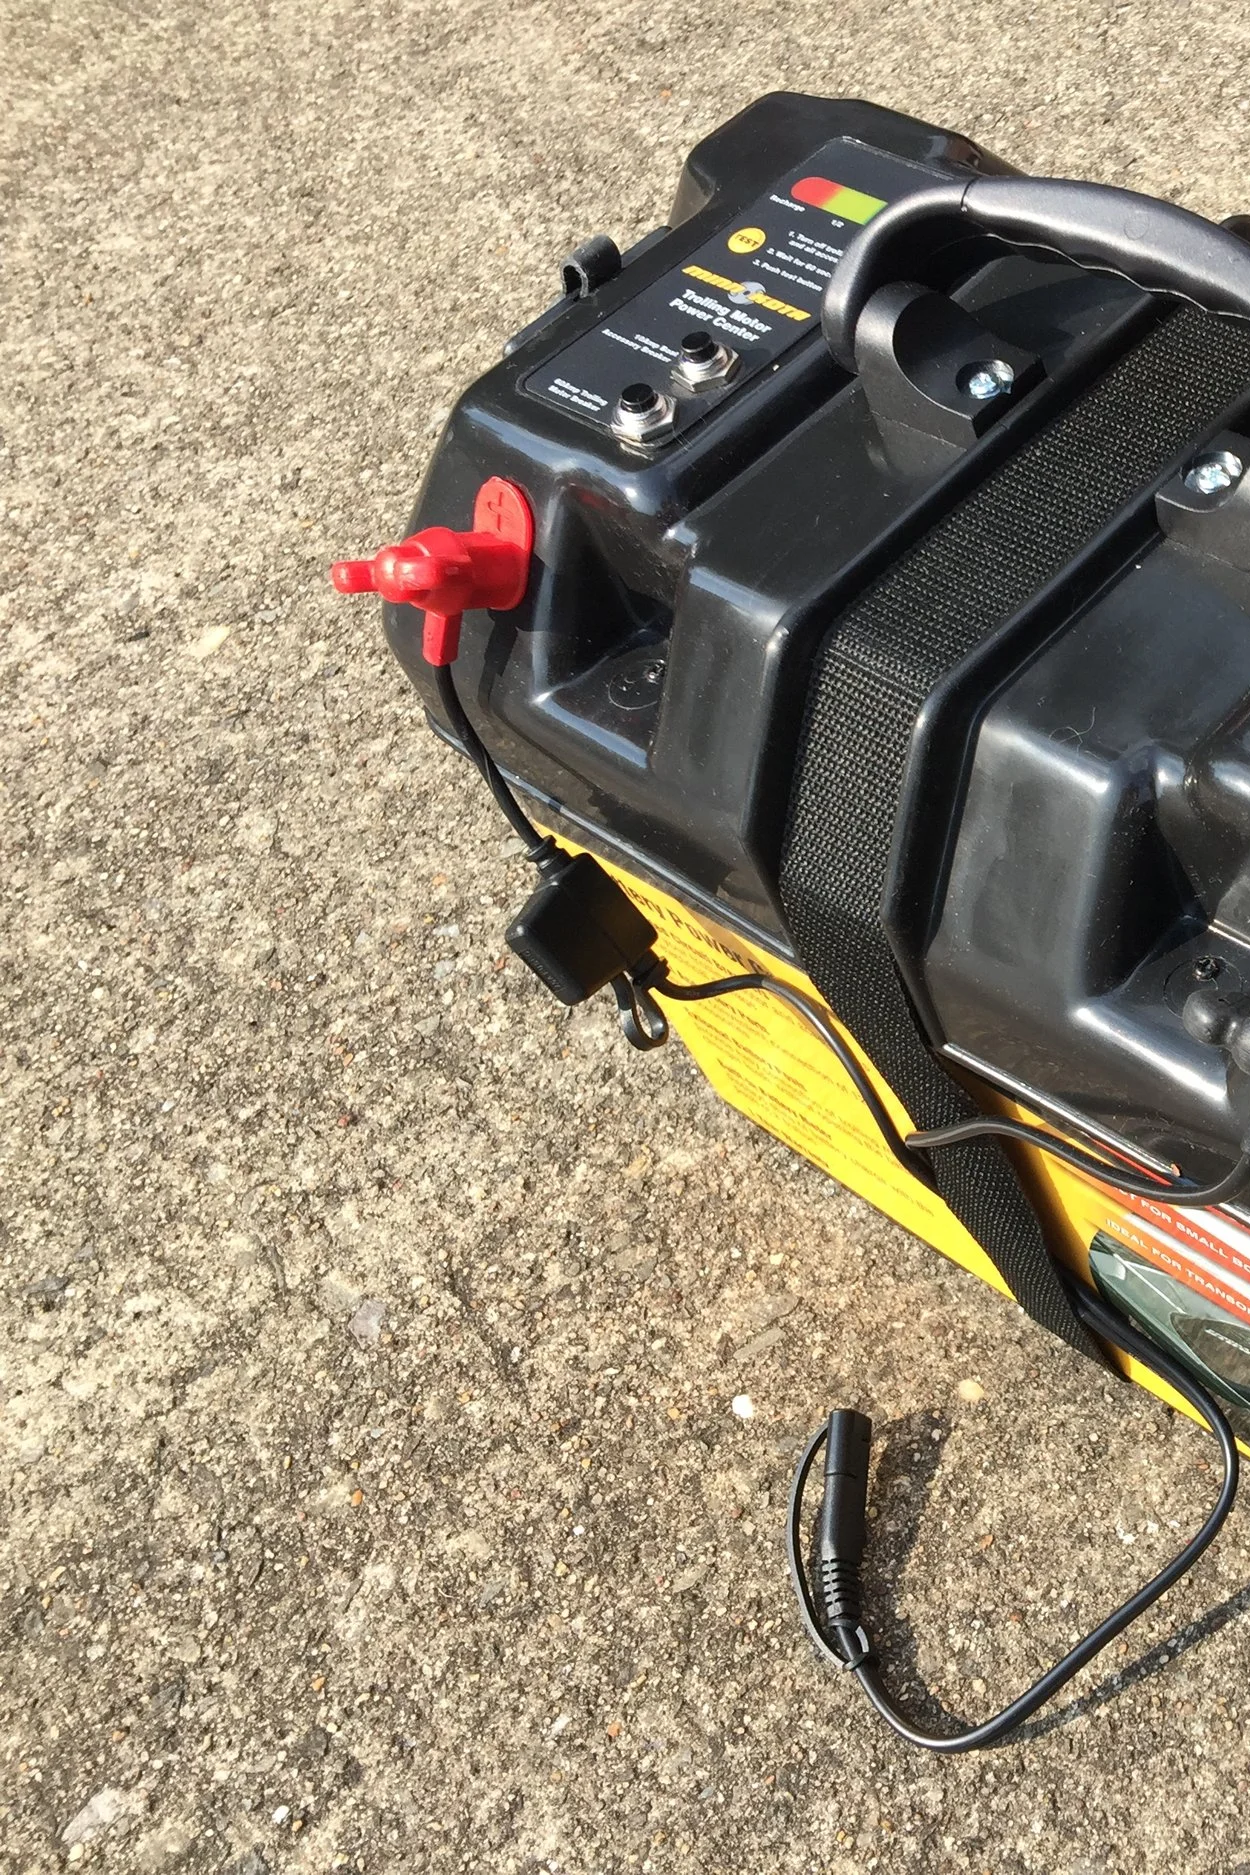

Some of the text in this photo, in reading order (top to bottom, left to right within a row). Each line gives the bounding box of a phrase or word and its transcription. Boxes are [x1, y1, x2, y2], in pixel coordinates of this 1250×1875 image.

[769, 194, 806, 212] Recharge
[734, 234, 760, 248] TEST
[788, 240, 839, 263] and all acces
[797, 233, 815, 245] Turn
[814, 241, 828, 249] off
[825, 245, 844, 257] troll
[775, 250, 794, 262] Wait
[793, 258, 806, 267] for
[805, 263, 817, 271] 60
[760, 262, 781, 274] Push
[780, 270, 798, 281] test
[796, 276, 823, 292] button
[668, 297, 760, 342] Power Center
[682, 289, 772, 333] Trolling Motor
[1140, 1199, 1172, 1223] FOR
[1175, 1221, 1228, 1258] SMALL
[1106, 1218, 1148, 1250] IDEAL
[1151, 1247, 1182, 1271] FOR
